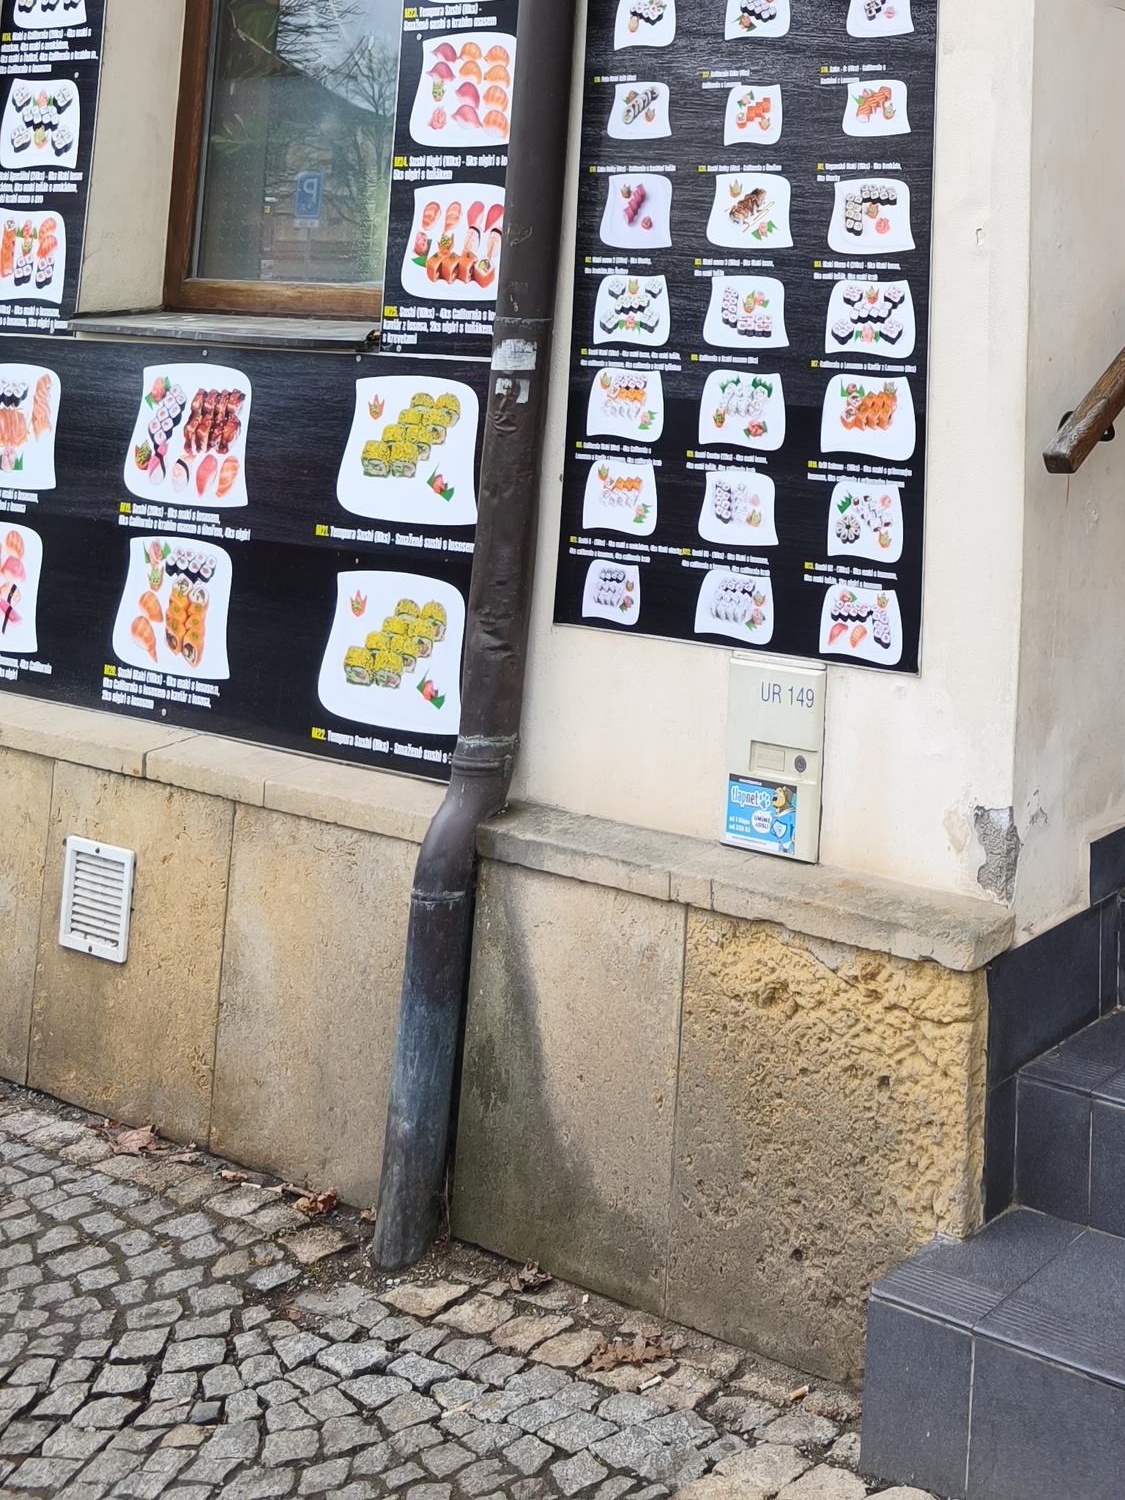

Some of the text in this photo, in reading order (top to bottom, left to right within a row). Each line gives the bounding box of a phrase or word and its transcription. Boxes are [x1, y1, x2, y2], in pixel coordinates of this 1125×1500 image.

[357, 529, 374, 542] Sushi
[424, 537, 442, 549] sushi
[761, 682, 814, 708] UR 149
[355, 735, 372, 749] Sushi
[423, 749, 442, 763] sushi
[732, 787, 759, 807] tlapnet
